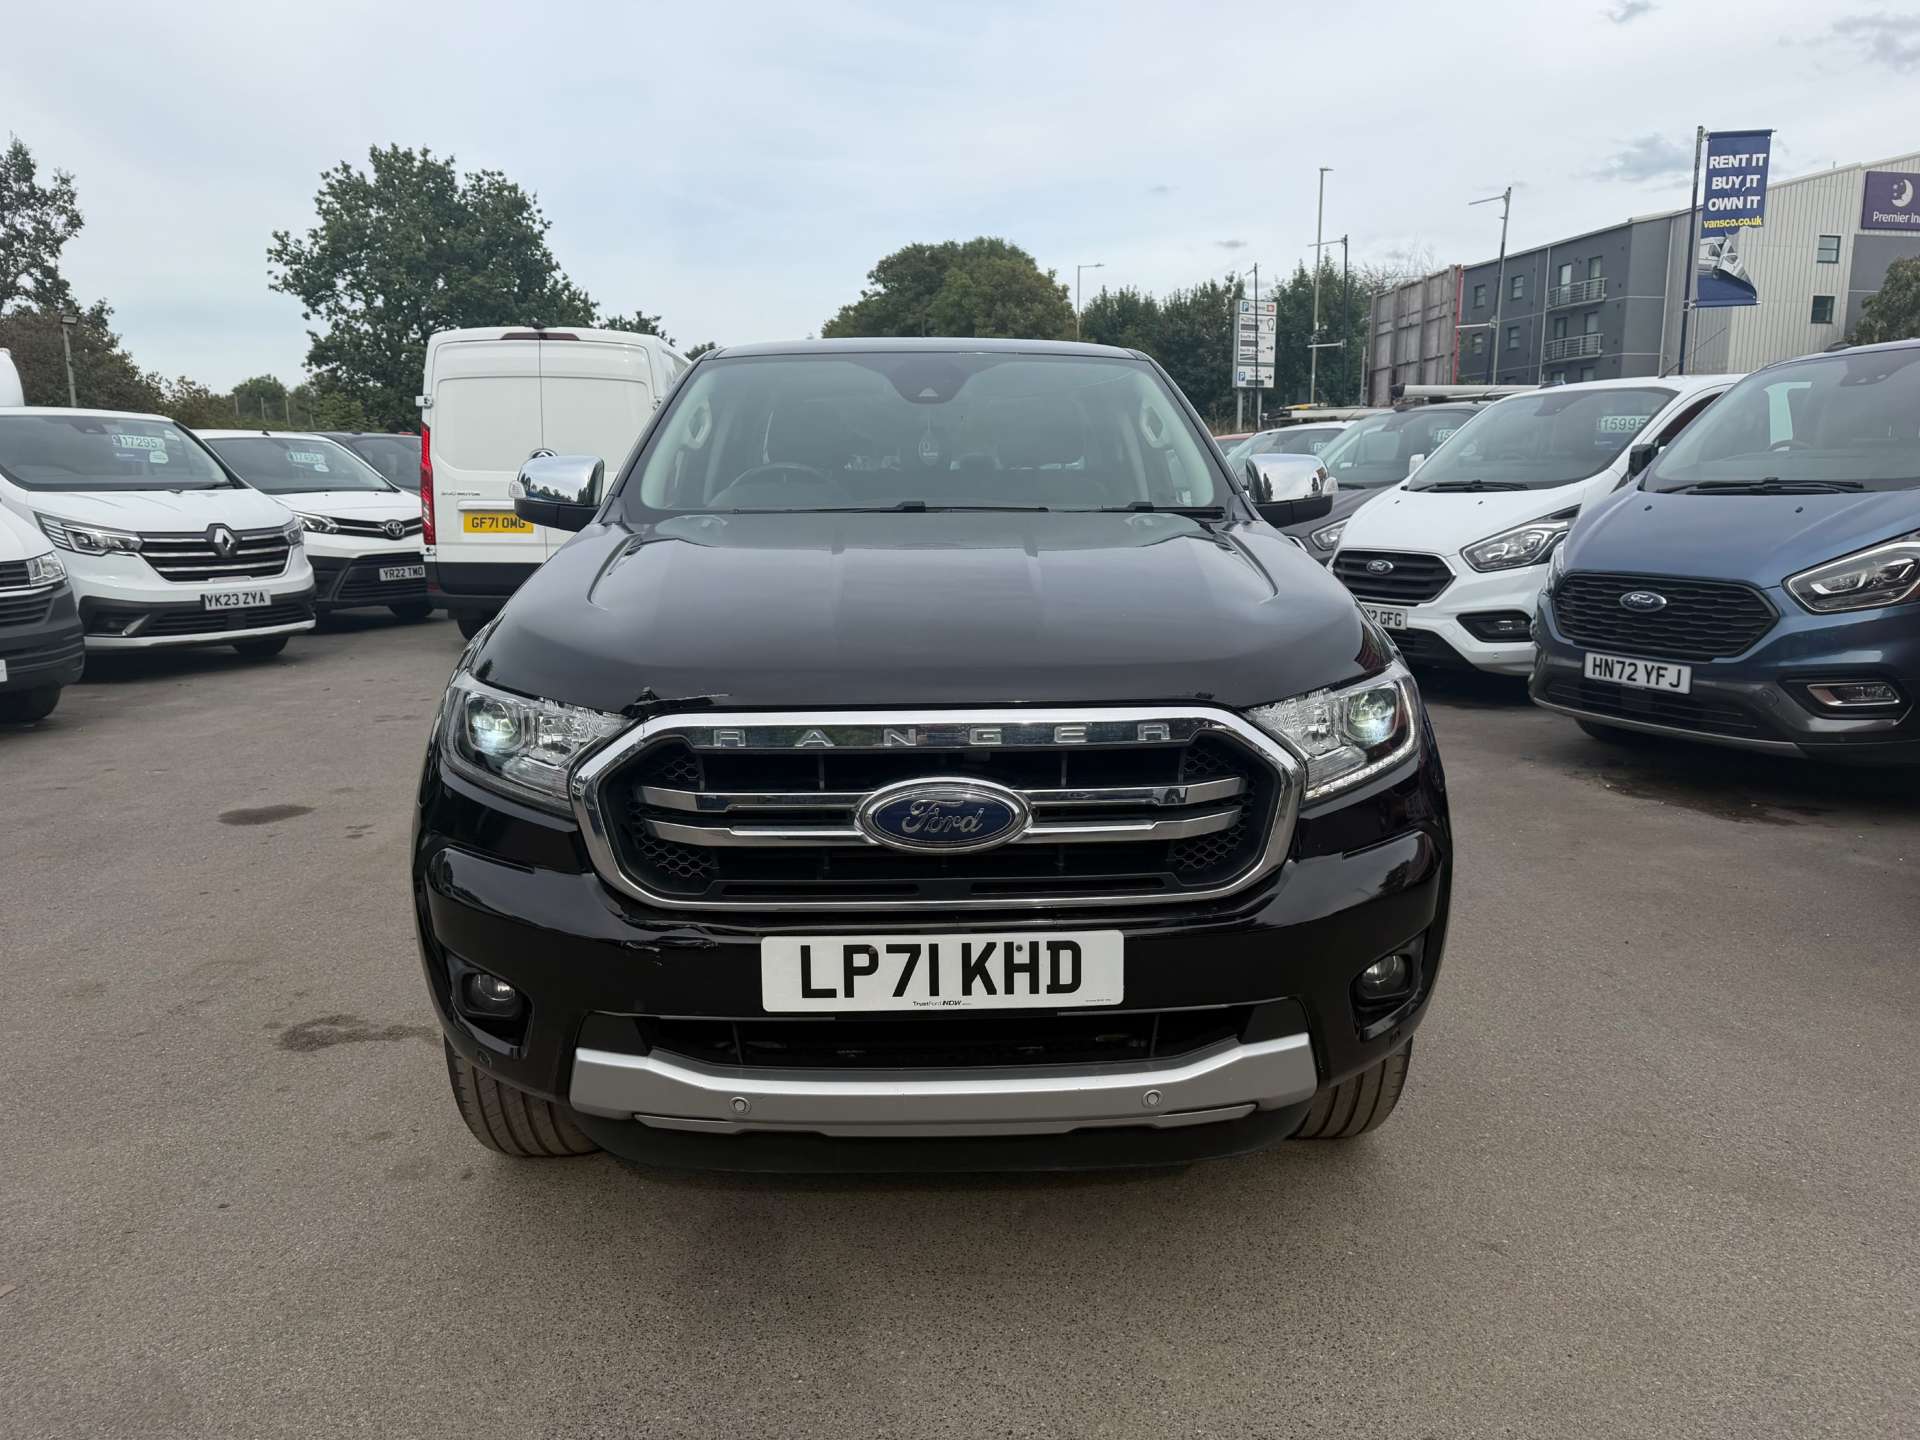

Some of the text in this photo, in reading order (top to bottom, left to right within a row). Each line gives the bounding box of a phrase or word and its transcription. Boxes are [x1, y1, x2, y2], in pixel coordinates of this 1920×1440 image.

[1709, 153, 1767, 169] RENT IT
[1711, 174, 1760, 190] BUY IT
[1708, 195, 1760, 212] OWN IT
[1703, 216, 1762, 228] vansco.co.uk
[1873, 211, 1920, 223] Premier In
[471, 517, 526, 529] GF71 OMG
[383, 568, 407, 579] YR22
[206, 591, 266, 607] YK23 ZYA
[1380, 611, 1402, 627] GFG
[1592, 656, 1682, 688] HN72 YFJ
[712, 723, 1170, 747] RANGER
[902, 800, 984, 834] Ford
[800, 940, 1083, 999] LP71 KHD
